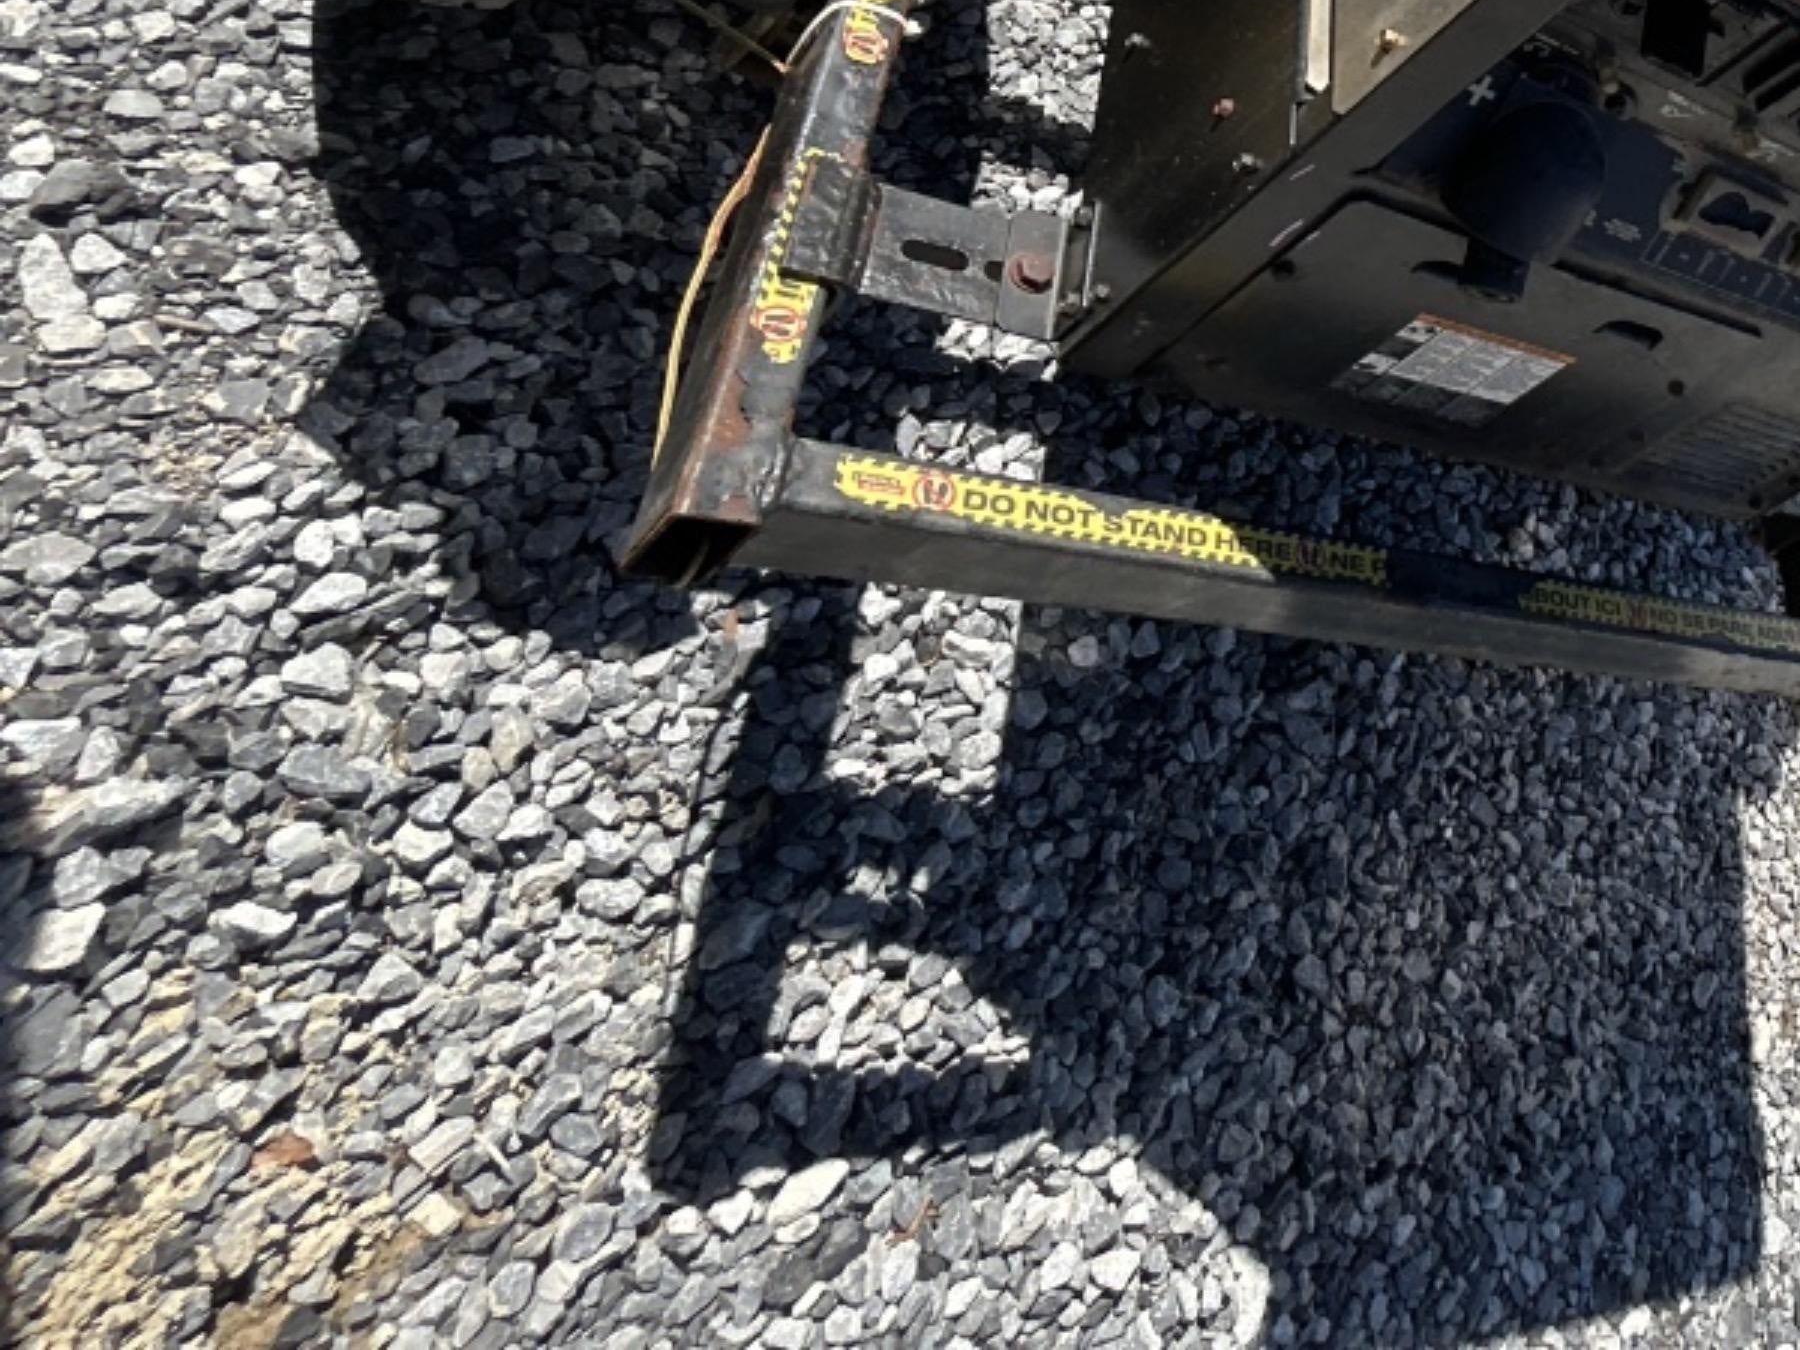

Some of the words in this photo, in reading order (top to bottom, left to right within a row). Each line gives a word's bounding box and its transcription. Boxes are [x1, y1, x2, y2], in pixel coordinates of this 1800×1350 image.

[963, 490, 1015, 514] DO
[1025, 500, 1095, 528] NOT
[1102, 515, 1206, 546] STAND
[1216, 532, 1290, 561] HERE
[1533, 590, 1587, 609] BOUT
